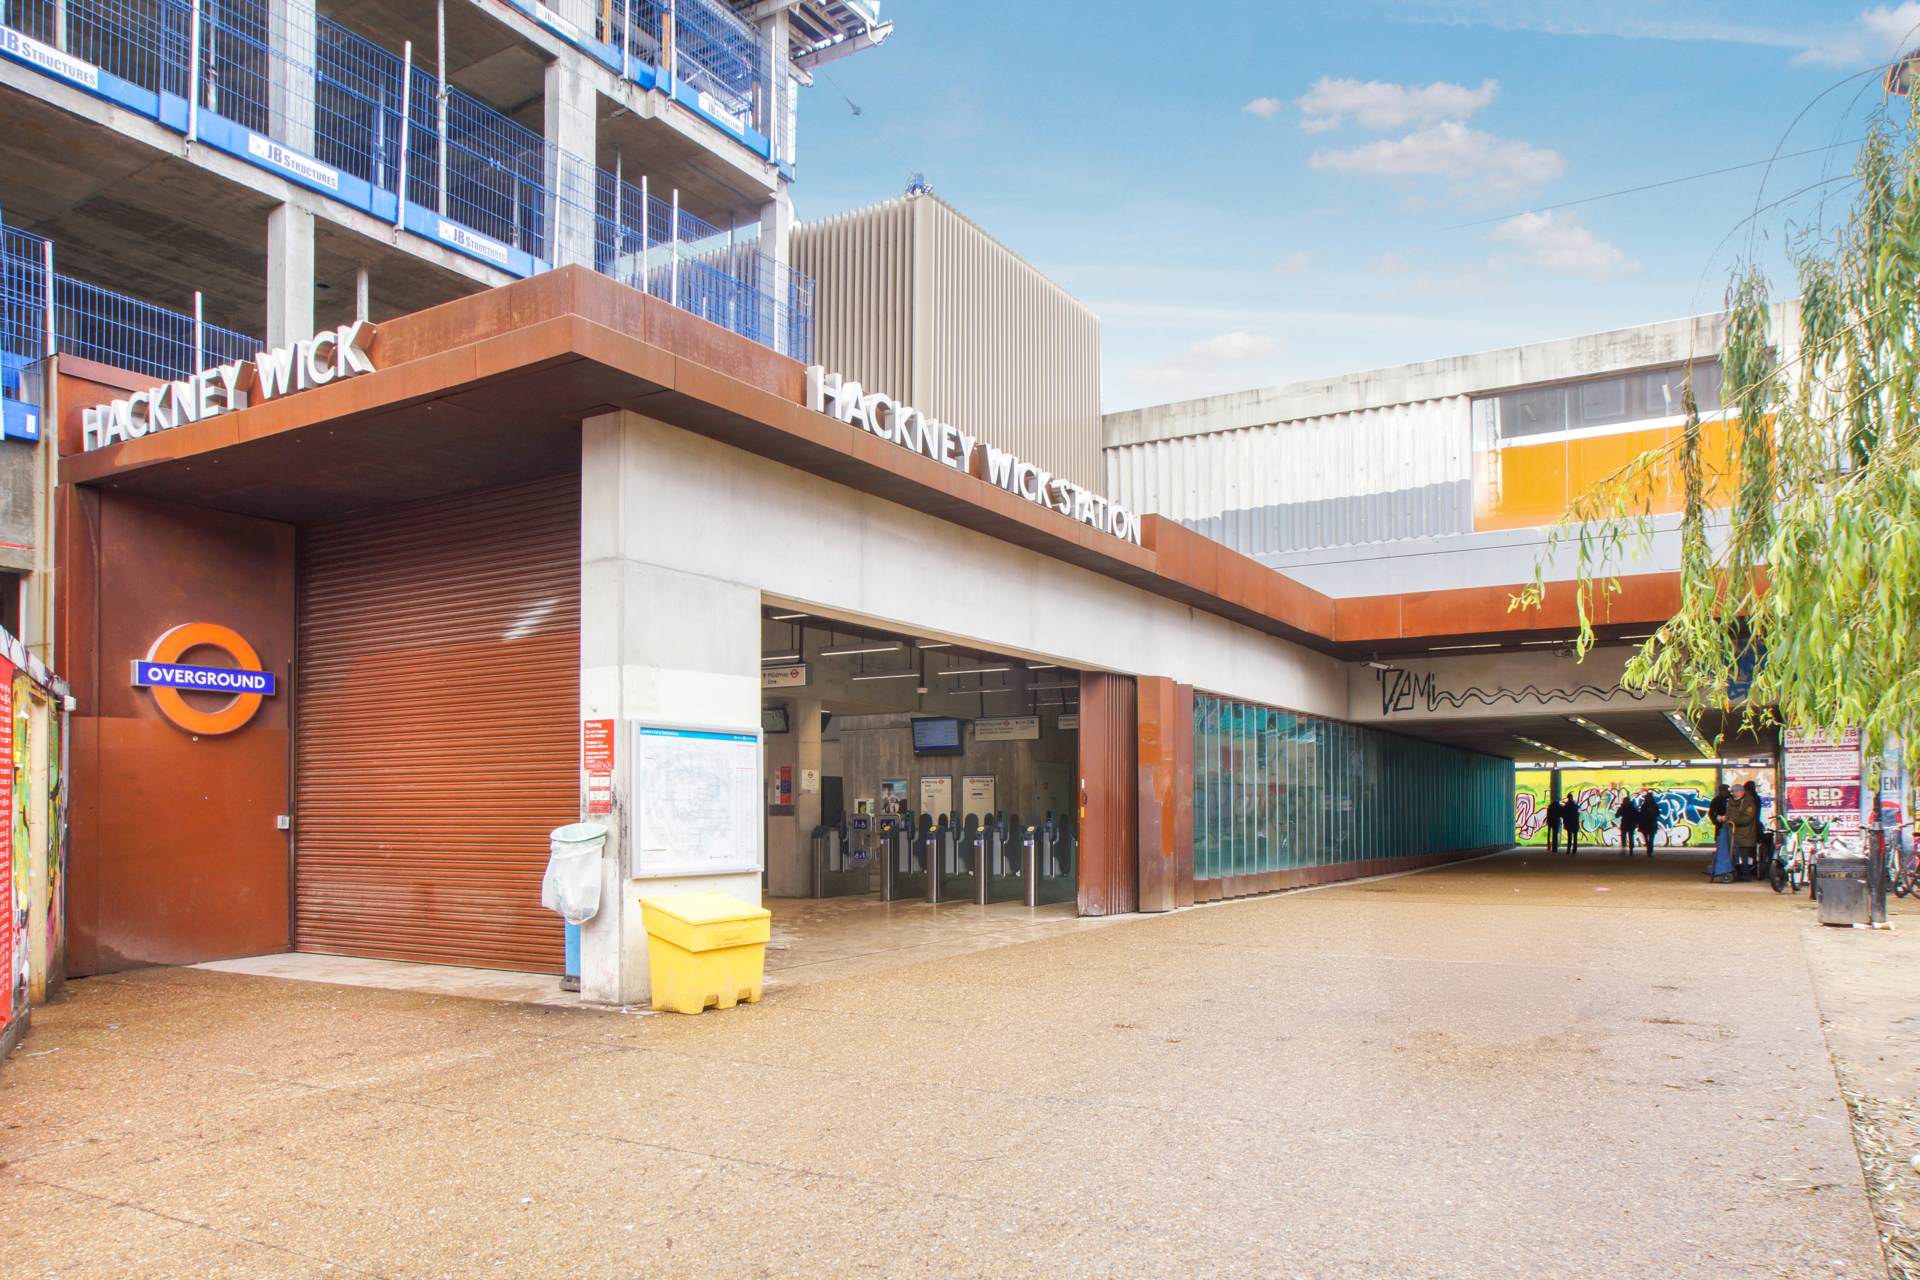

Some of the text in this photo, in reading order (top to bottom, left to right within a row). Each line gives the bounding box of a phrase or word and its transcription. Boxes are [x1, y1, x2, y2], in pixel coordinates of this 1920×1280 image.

[22, 42, 96, 86] STRUCTURES
[267, 144, 336, 188] JB STRUCTURES
[453, 228, 465, 245] JB
[82, 319, 376, 452] HACKNEY WICK
[808, 365, 1142, 547] HACKNEY WICK STATION
[147, 667, 266, 690] OVERGROUND
[1806, 788, 1843, 801] RED
